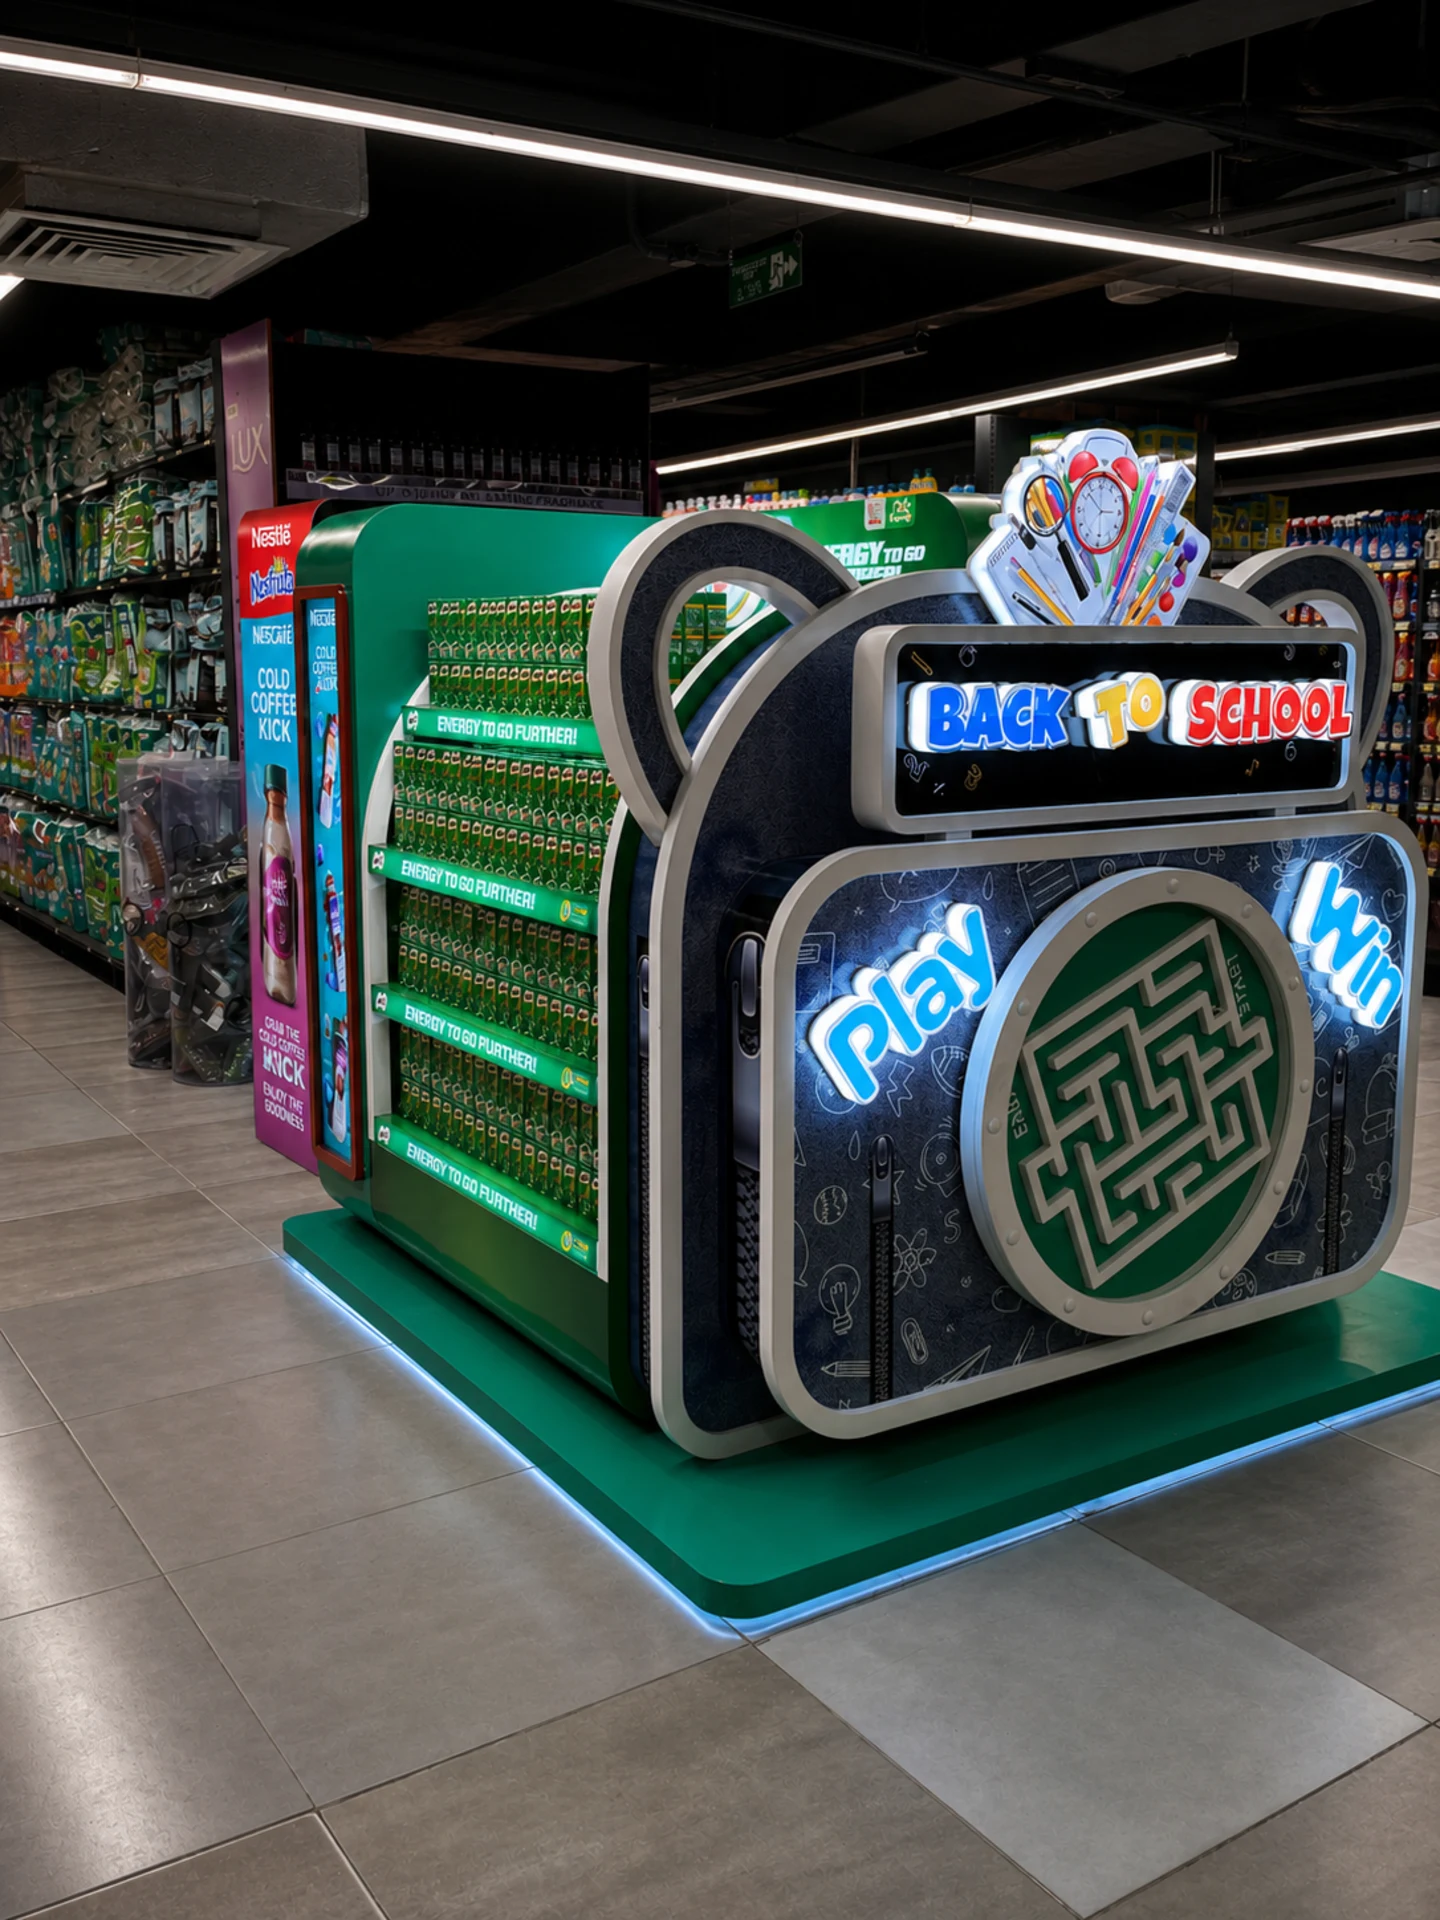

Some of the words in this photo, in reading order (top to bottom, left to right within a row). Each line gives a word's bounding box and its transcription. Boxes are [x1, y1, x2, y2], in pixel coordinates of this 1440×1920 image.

[232, 424, 268, 472] LUX
[251, 523, 291, 549] Nestlé
[884, 547, 904, 564] TO
[904, 545, 926, 562] GO
[257, 667, 290, 691] COLD
[251, 691, 297, 717] COFFEE
[922, 682, 1072, 751] BACK
[1088, 673, 1166, 749] TO
[1186, 681, 1355, 747] SCHOOL
[258, 717, 292, 743] KICK
[437, 715, 481, 736] ENERGY
[482, 720, 496, 738] TO
[497, 722, 513, 740] GO
[514, 725, 578, 745] FURTHER!
[401, 859, 443, 885] ENERGY
[444, 871, 458, 889] TO
[459, 874, 475, 893] GO
[475, 878, 537, 910] FURTHER!
[1299, 862, 1404, 1029] Win
[816, 903, 997, 1105] Play
[447, 1023, 461, 1041] TO
[462, 1028, 477, 1047] GO
[406, 1142, 448, 1177] ENERGY
[448, 1165, 462, 1185] TO
[462, 1172, 478, 1195] GO
[479, 1183, 538, 1230] FURTHER!
